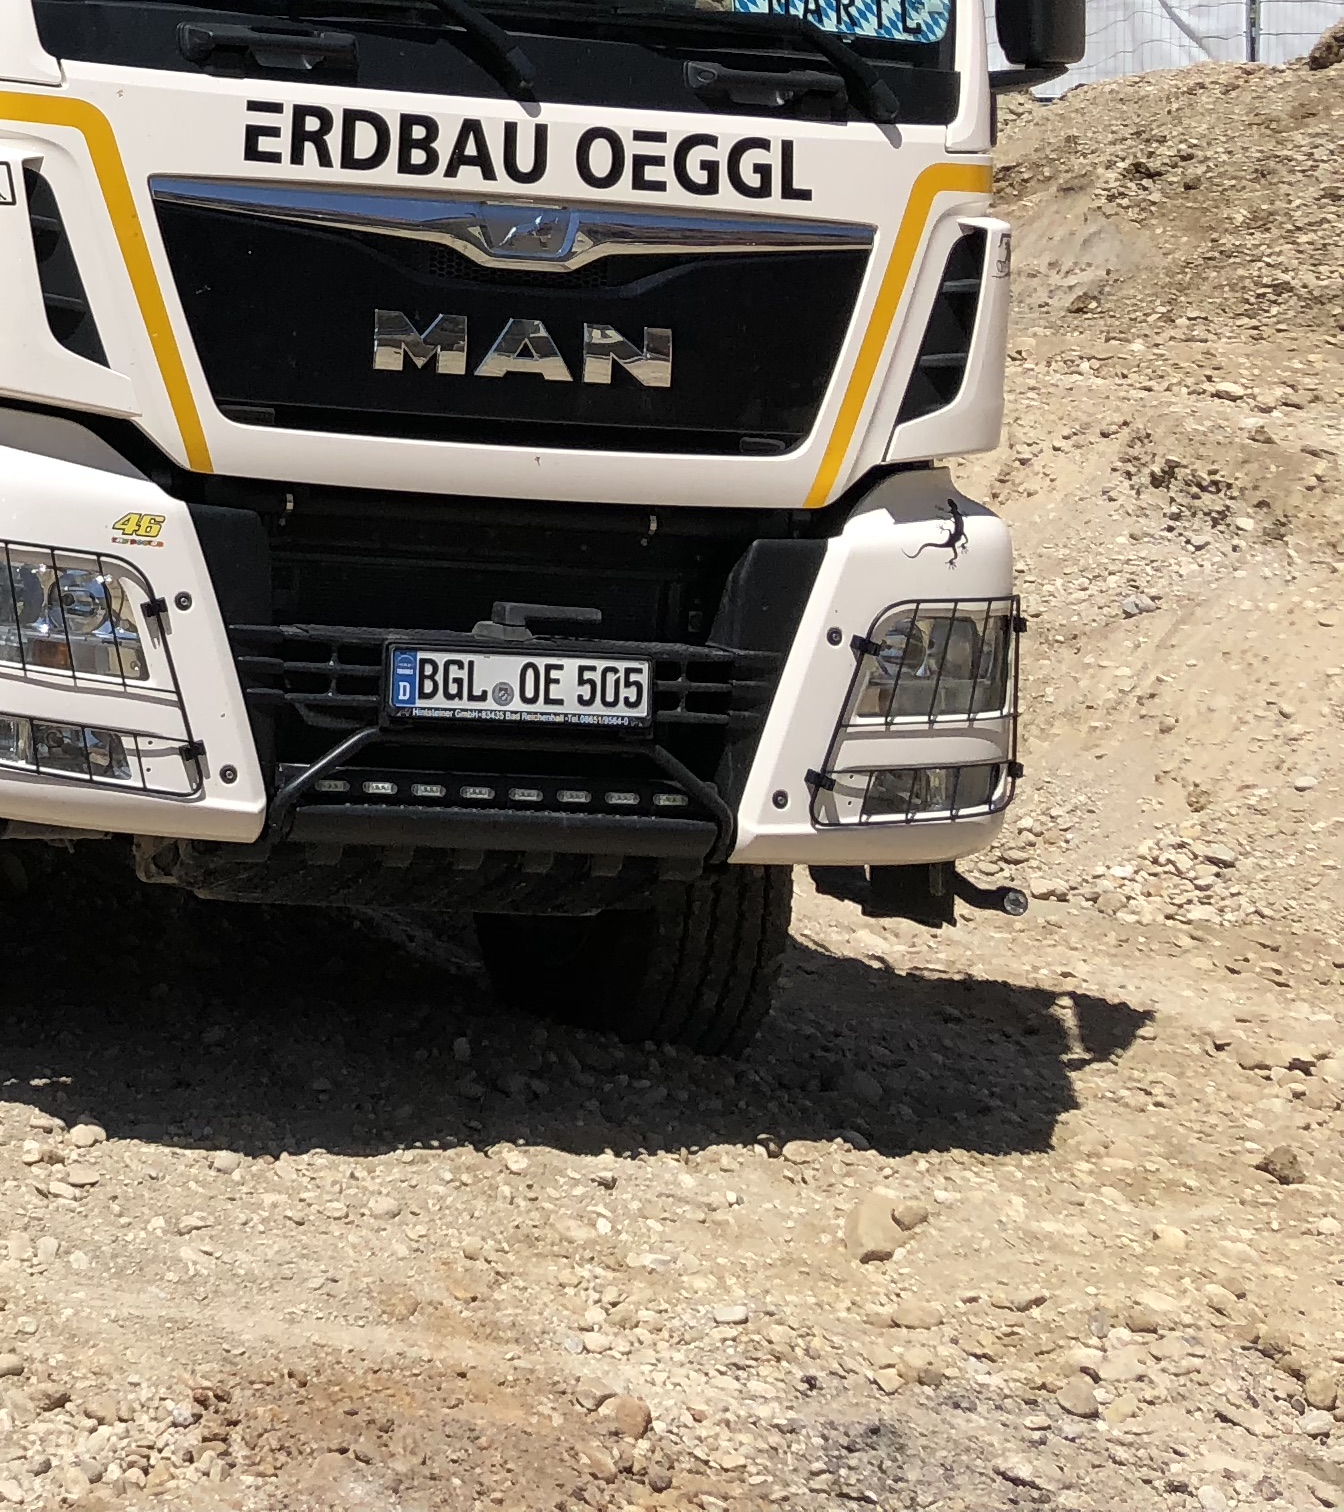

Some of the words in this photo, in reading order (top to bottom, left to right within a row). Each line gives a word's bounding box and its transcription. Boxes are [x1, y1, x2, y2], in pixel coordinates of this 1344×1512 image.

[242, 99, 546, 185] ERDBAU
[575, 125, 813, 201] OEGGL
[371, 307, 673, 388] MAN
[111, 511, 166, 538] 46
[398, 681, 411, 701] D
[417, 657, 489, 703] BGL
[519, 661, 565, 707] OE
[576, 664, 644, 710] 505
[505, 711, 521, 721] Bad
[521, 711, 565, 723] Reichenhall
